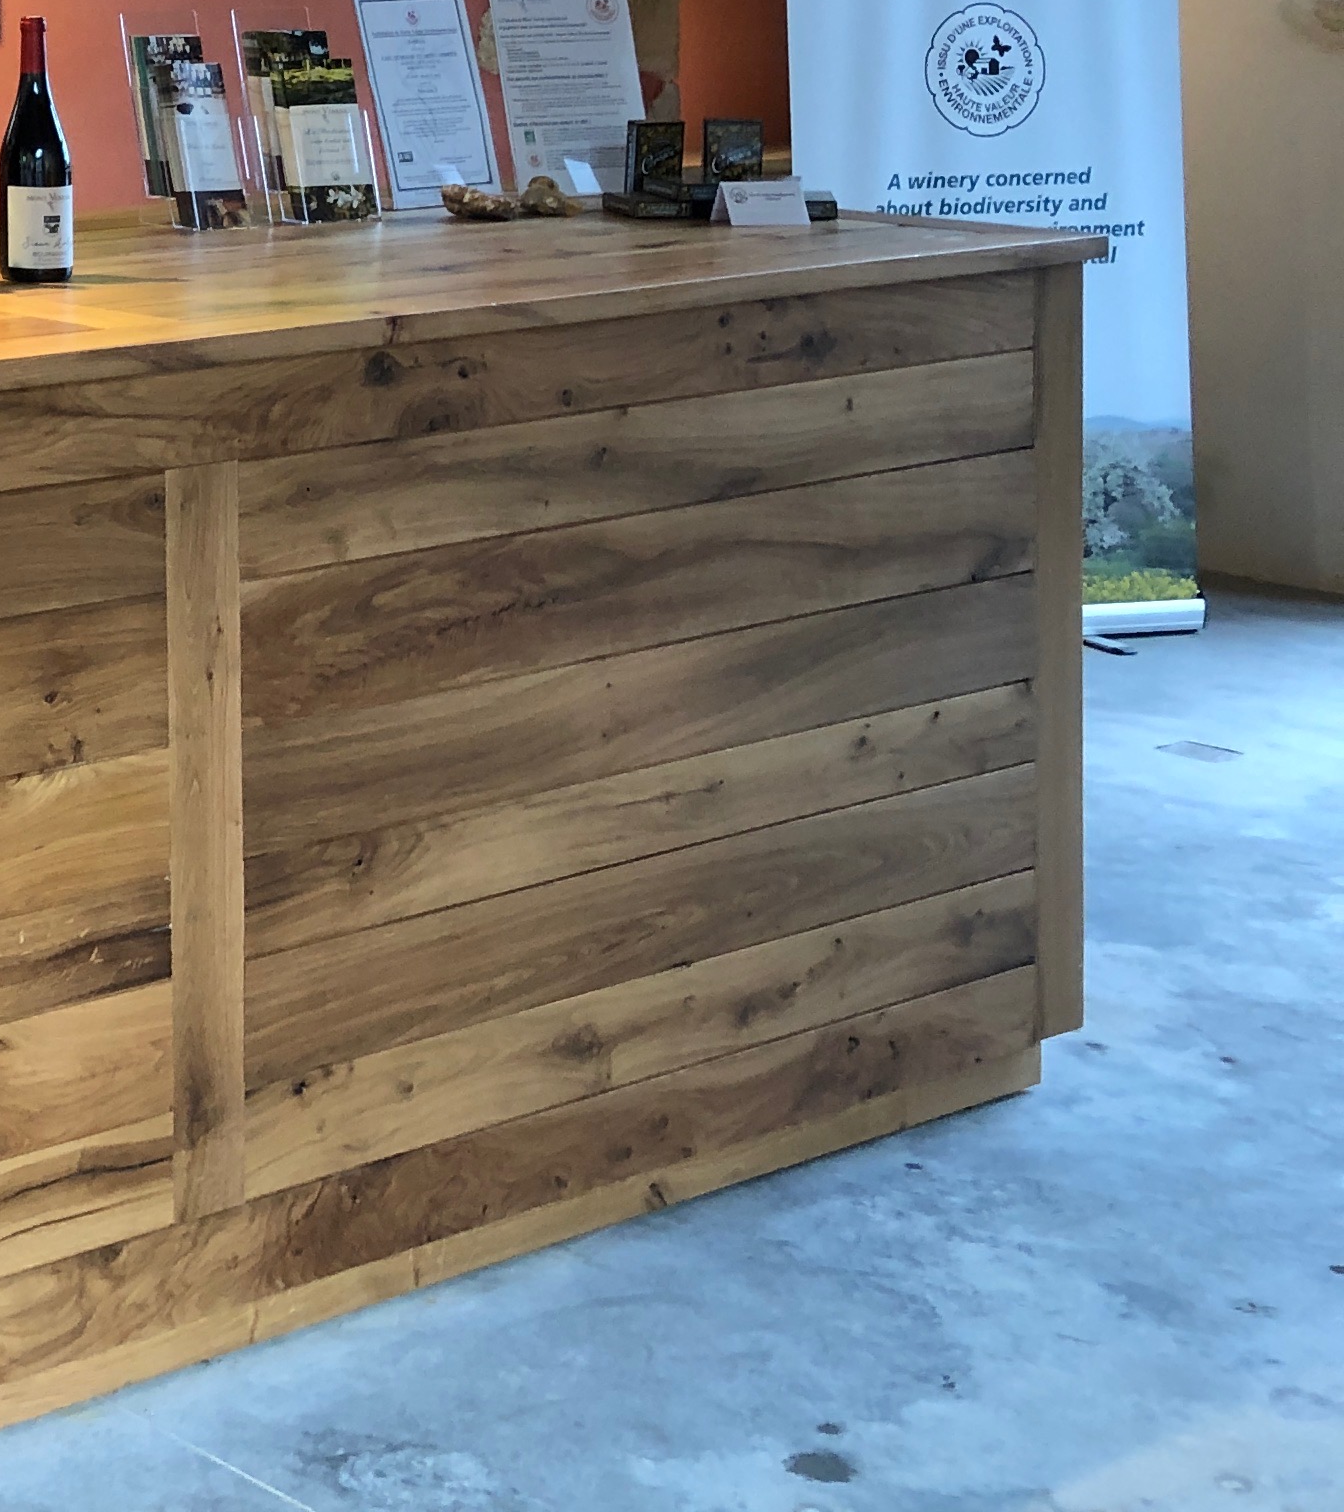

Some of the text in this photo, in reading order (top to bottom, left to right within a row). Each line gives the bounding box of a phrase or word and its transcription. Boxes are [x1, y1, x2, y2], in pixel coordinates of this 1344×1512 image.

[937, 16, 1033, 70] ISSU D'UNE EXPLOITATION
[939, 78, 1033, 124] ENVIRONNEMENTALE
[952, 83, 1020, 112] HAUTE VALEUR
[887, 166, 1092, 193] A winery concerned
[939, 195, 1063, 217] biodiversity
[1068, 192, 1108, 212] and
